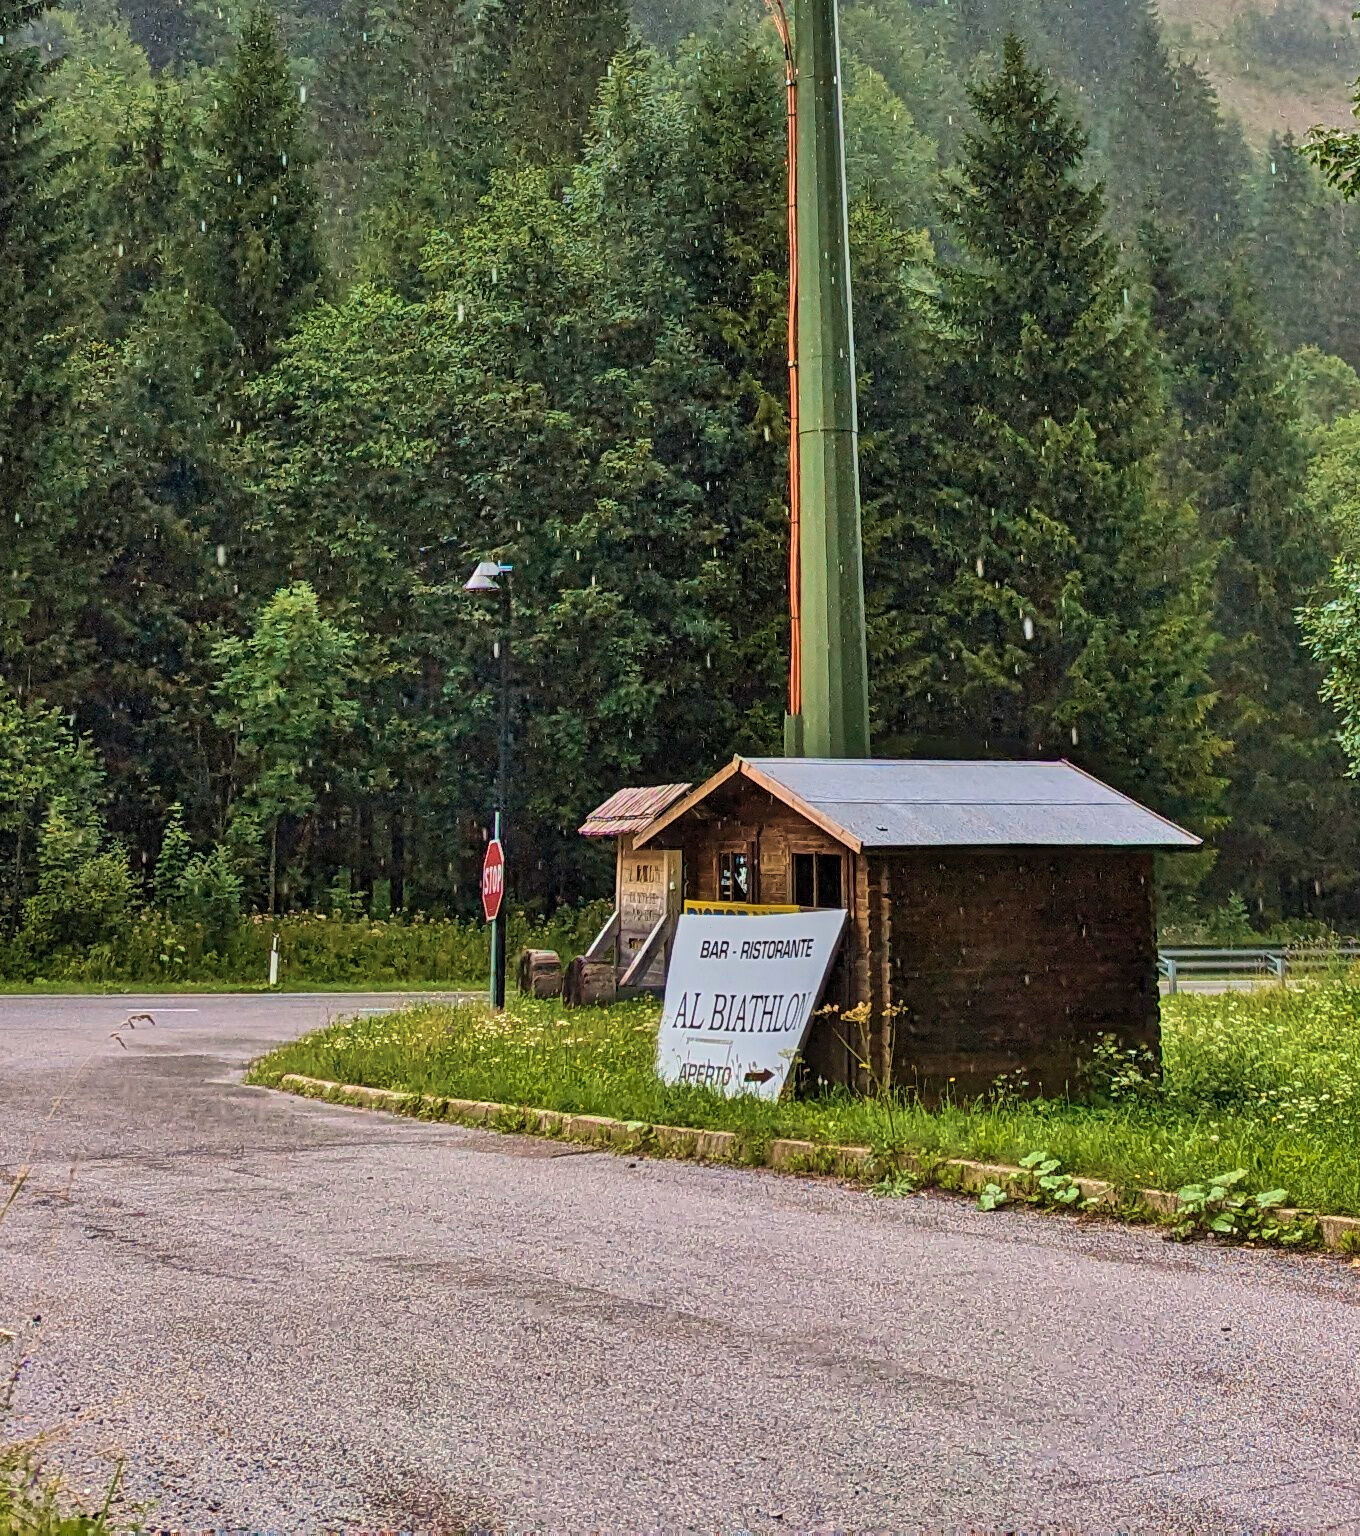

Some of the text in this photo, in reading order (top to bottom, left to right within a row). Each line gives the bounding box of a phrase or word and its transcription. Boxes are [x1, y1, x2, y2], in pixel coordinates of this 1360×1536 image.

[484, 864, 502, 895] STOP
[700, 940, 729, 959] BAR
[740, 938, 814, 959] RISTORANTE
[672, 991, 812, 1032] AL BIATHLON
[678, 1062, 732, 1086] APERTO
